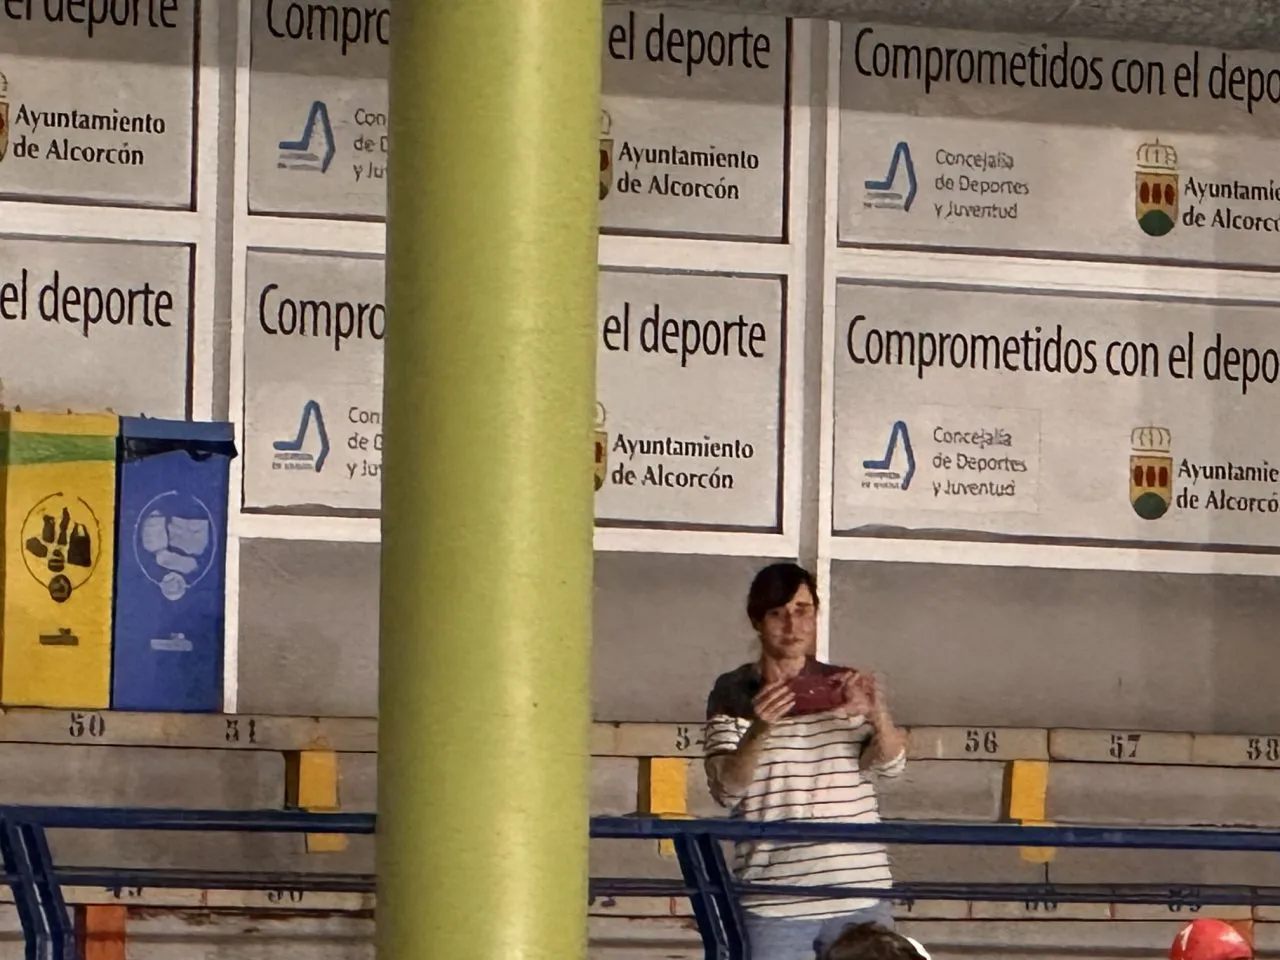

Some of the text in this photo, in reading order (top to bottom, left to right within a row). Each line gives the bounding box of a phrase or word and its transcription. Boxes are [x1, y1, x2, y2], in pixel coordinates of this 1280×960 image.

[267, 0, 391, 55] Compro
[608, 11, 770, 76] el deporte
[854, 27, 1102, 93] Comprometidos
[1112, 57, 1165, 95] con
[1174, 51, 1198, 98] el
[15, 104, 165, 134] Ayuntamiento
[13, 135, 144, 165] de Alcorcón
[618, 142, 759, 170] Ayuntamiento
[617, 171, 739, 199] de Alcorcón
[935, 175, 1030, 195] de Deportes
[946, 202, 1018, 219] Juventud
[1182, 206, 1206, 228] de
[0, 268, 173, 337] el deporte
[259, 284, 386, 351] Compro
[603, 302, 766, 367] el deporte
[847, 315, 1097, 378] Comprometidos
[1106, 340, 1158, 377] con
[1168, 333, 1194, 378] el
[613, 434, 753, 460] Ayuntamiento
[612, 463, 734, 488] de Alcorcón
[933, 452, 1027, 473] de Deportes
[943, 479, 1015, 496] Juventud
[1176, 488, 1199, 510] de
[69, 712, 105, 737] 50
[965, 730, 999, 753] 56
[1109, 734, 1141, 759] 57
